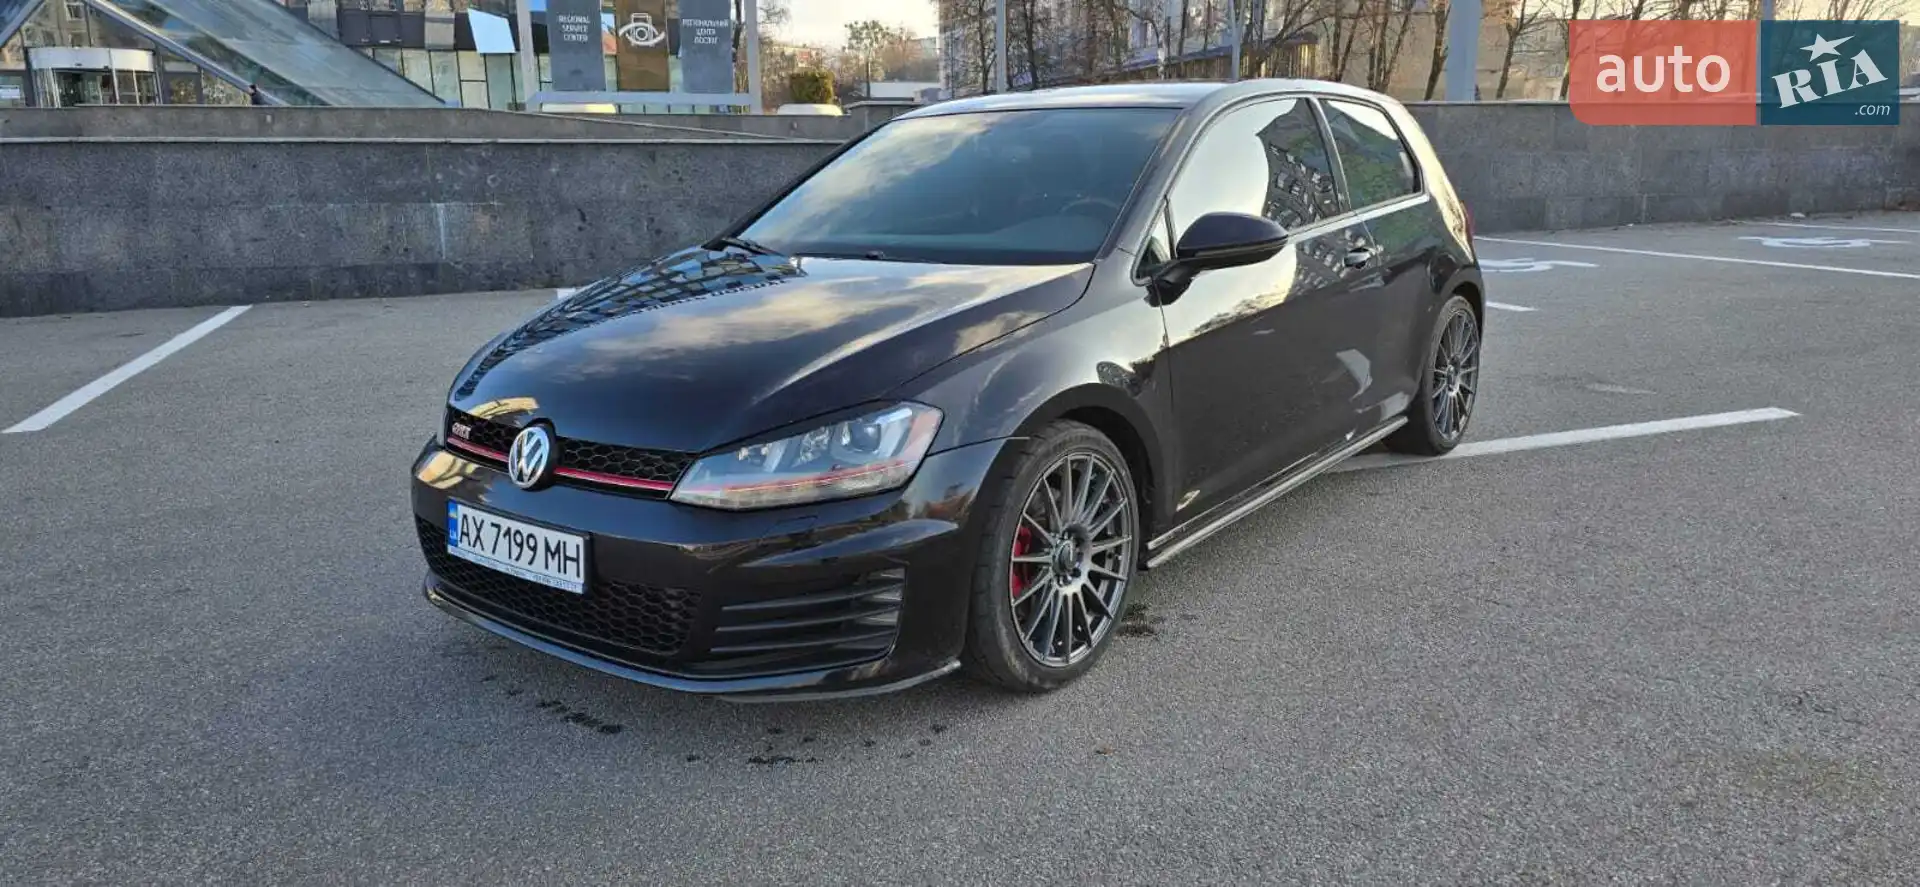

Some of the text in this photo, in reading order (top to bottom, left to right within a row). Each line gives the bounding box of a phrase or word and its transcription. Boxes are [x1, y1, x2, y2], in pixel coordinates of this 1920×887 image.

[558, 15, 590, 24] REGIONAL
[562, 24, 588, 32] SERVICE
[563, 33, 588, 41] CENTER
[459, 513, 581, 578] AX 7199 MH
